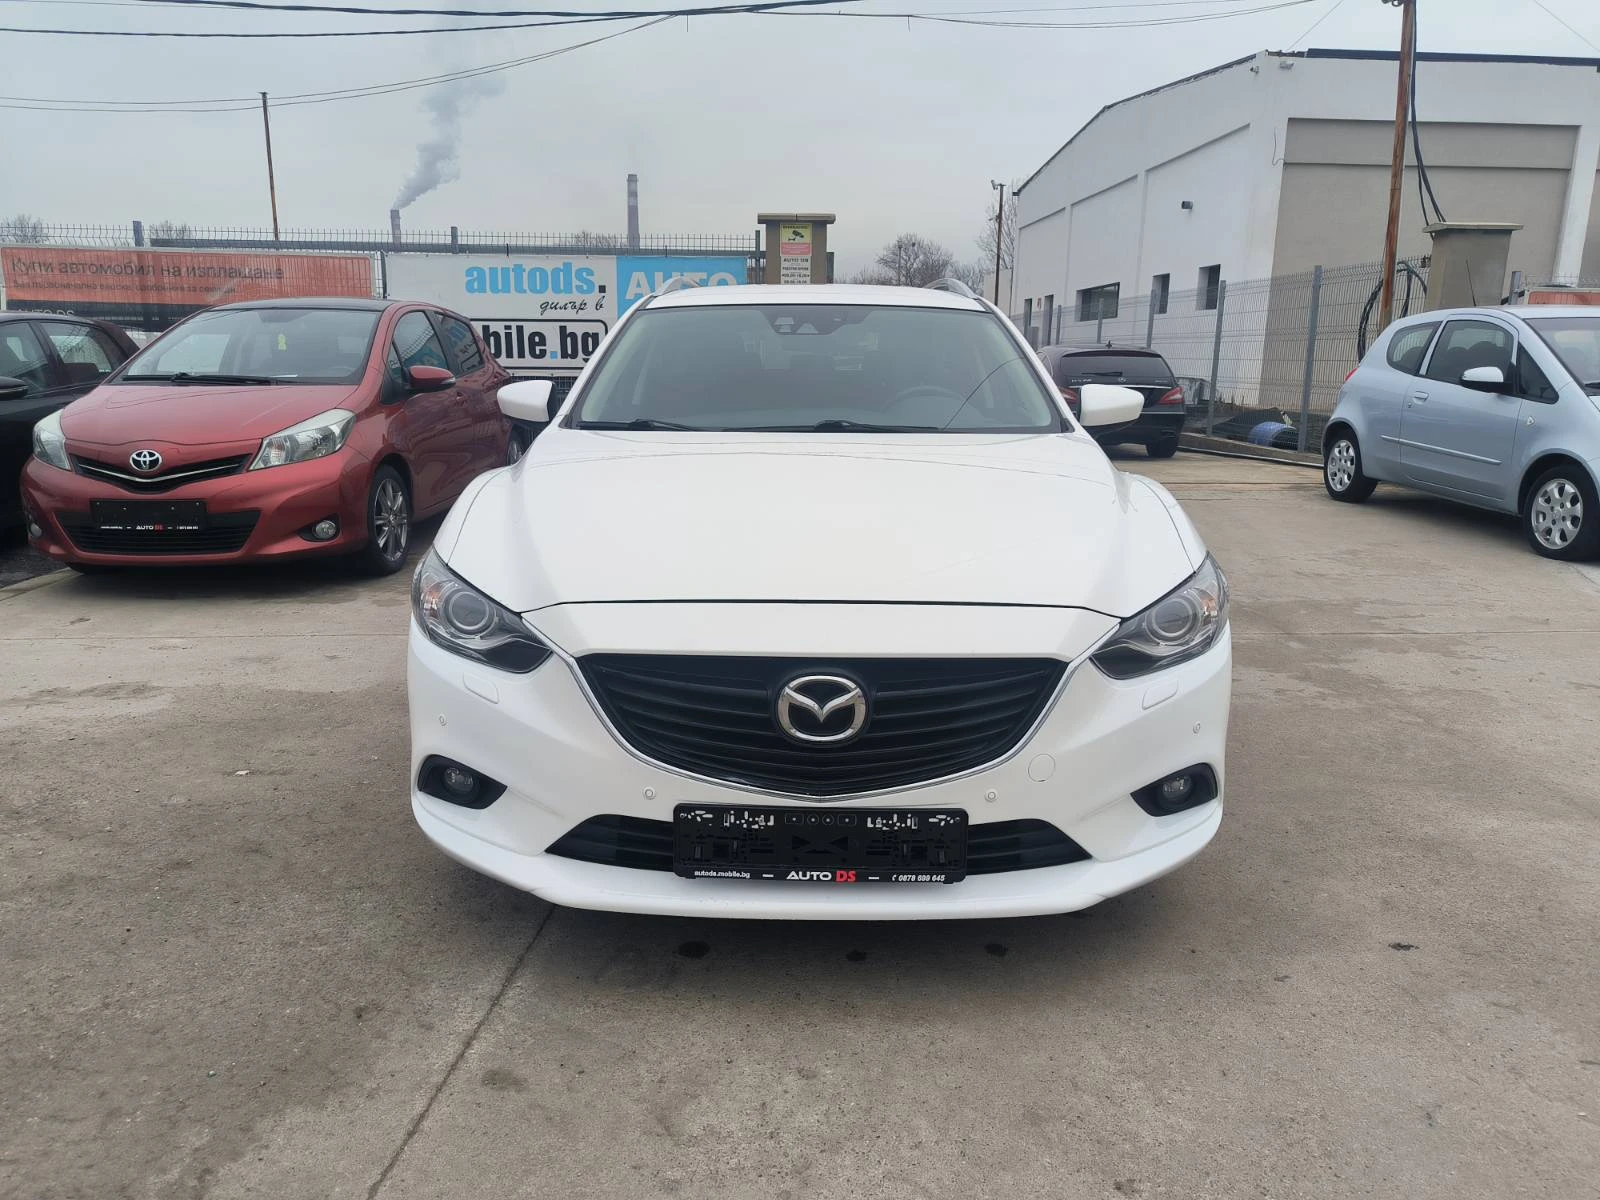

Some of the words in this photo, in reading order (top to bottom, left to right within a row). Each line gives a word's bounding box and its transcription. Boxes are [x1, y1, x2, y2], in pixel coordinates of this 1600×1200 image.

[11, 258, 54, 276] Купи
[59, 259, 155, 277] автомобил
[161, 265, 182, 277] на
[187, 266, 284, 281] изплащане
[786, 870, 832, 881] AUTO
[836, 870, 857, 882] DS
